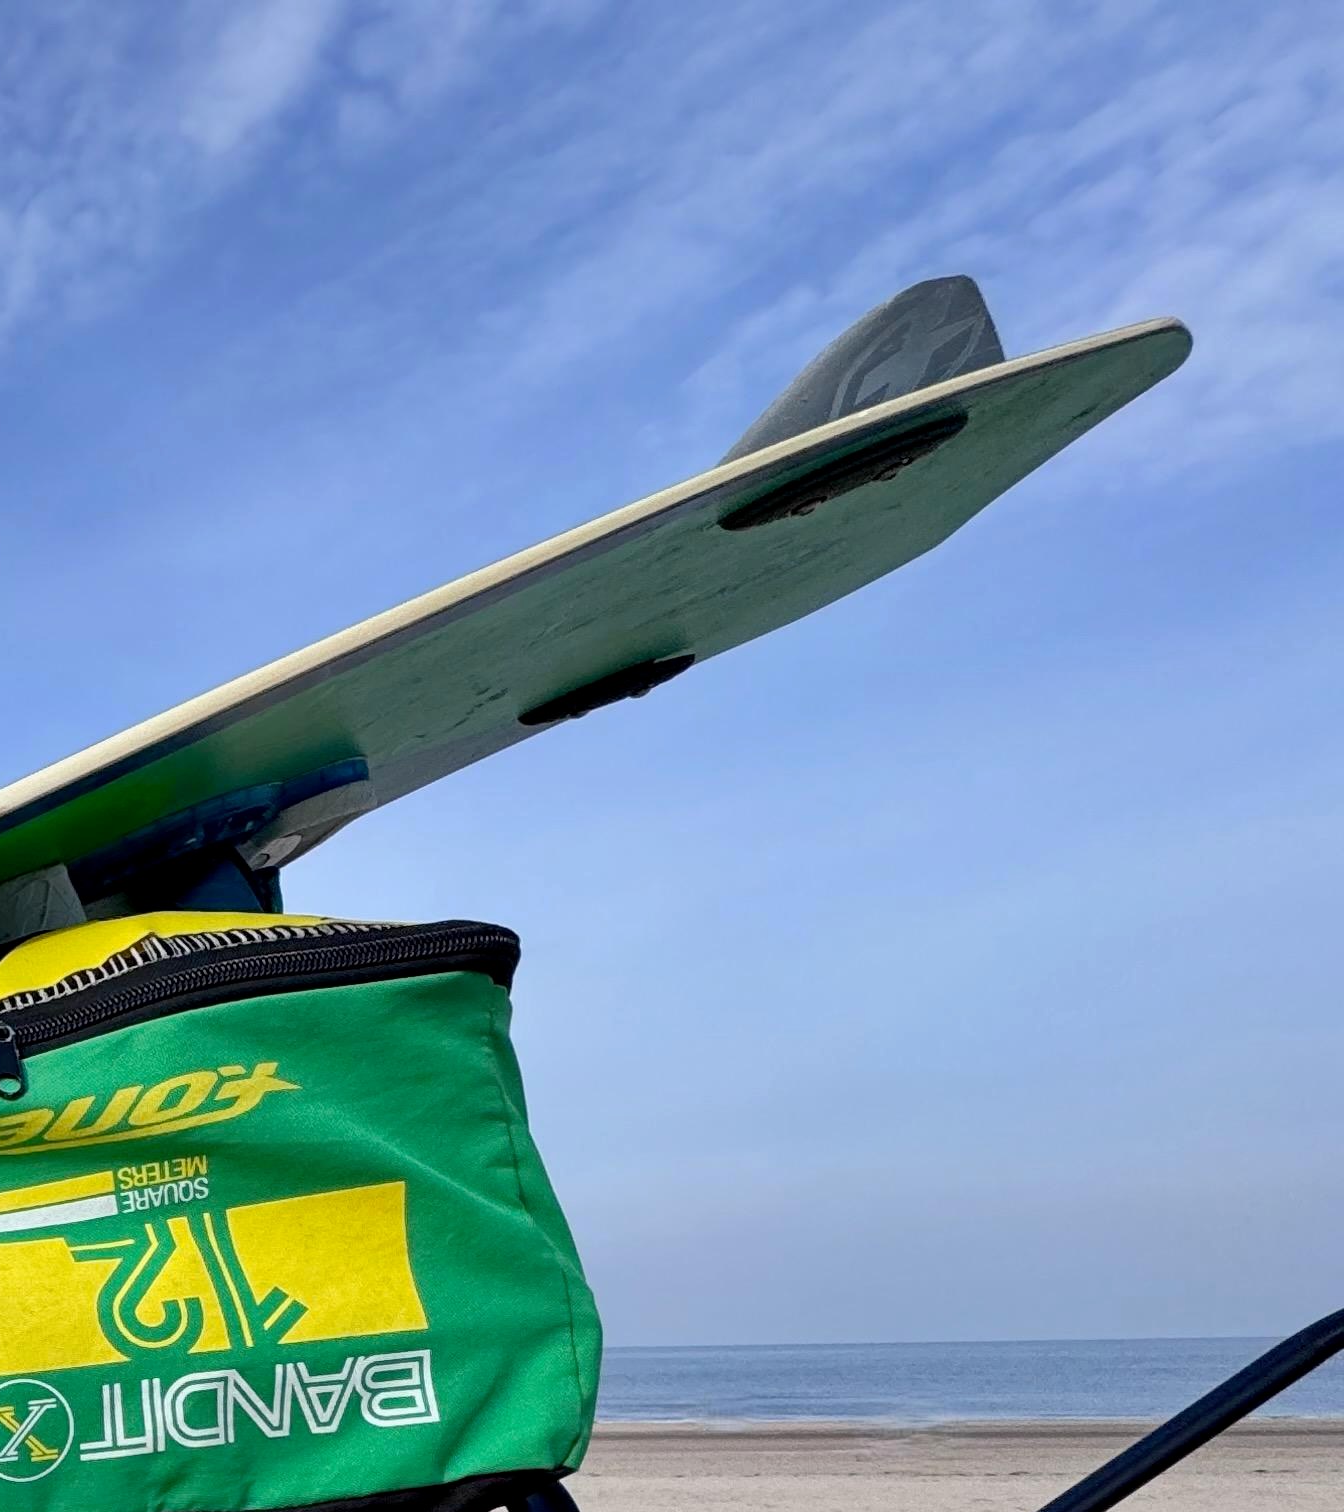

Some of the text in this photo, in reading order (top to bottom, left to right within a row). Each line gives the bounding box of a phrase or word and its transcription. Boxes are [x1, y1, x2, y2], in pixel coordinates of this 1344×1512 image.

[117, 1154, 209, 1191] METERS
[120, 1176, 211, 1214] SQUARE
[69, 1211, 311, 1359] 12
[79, 1348, 441, 1463] BANDIT
